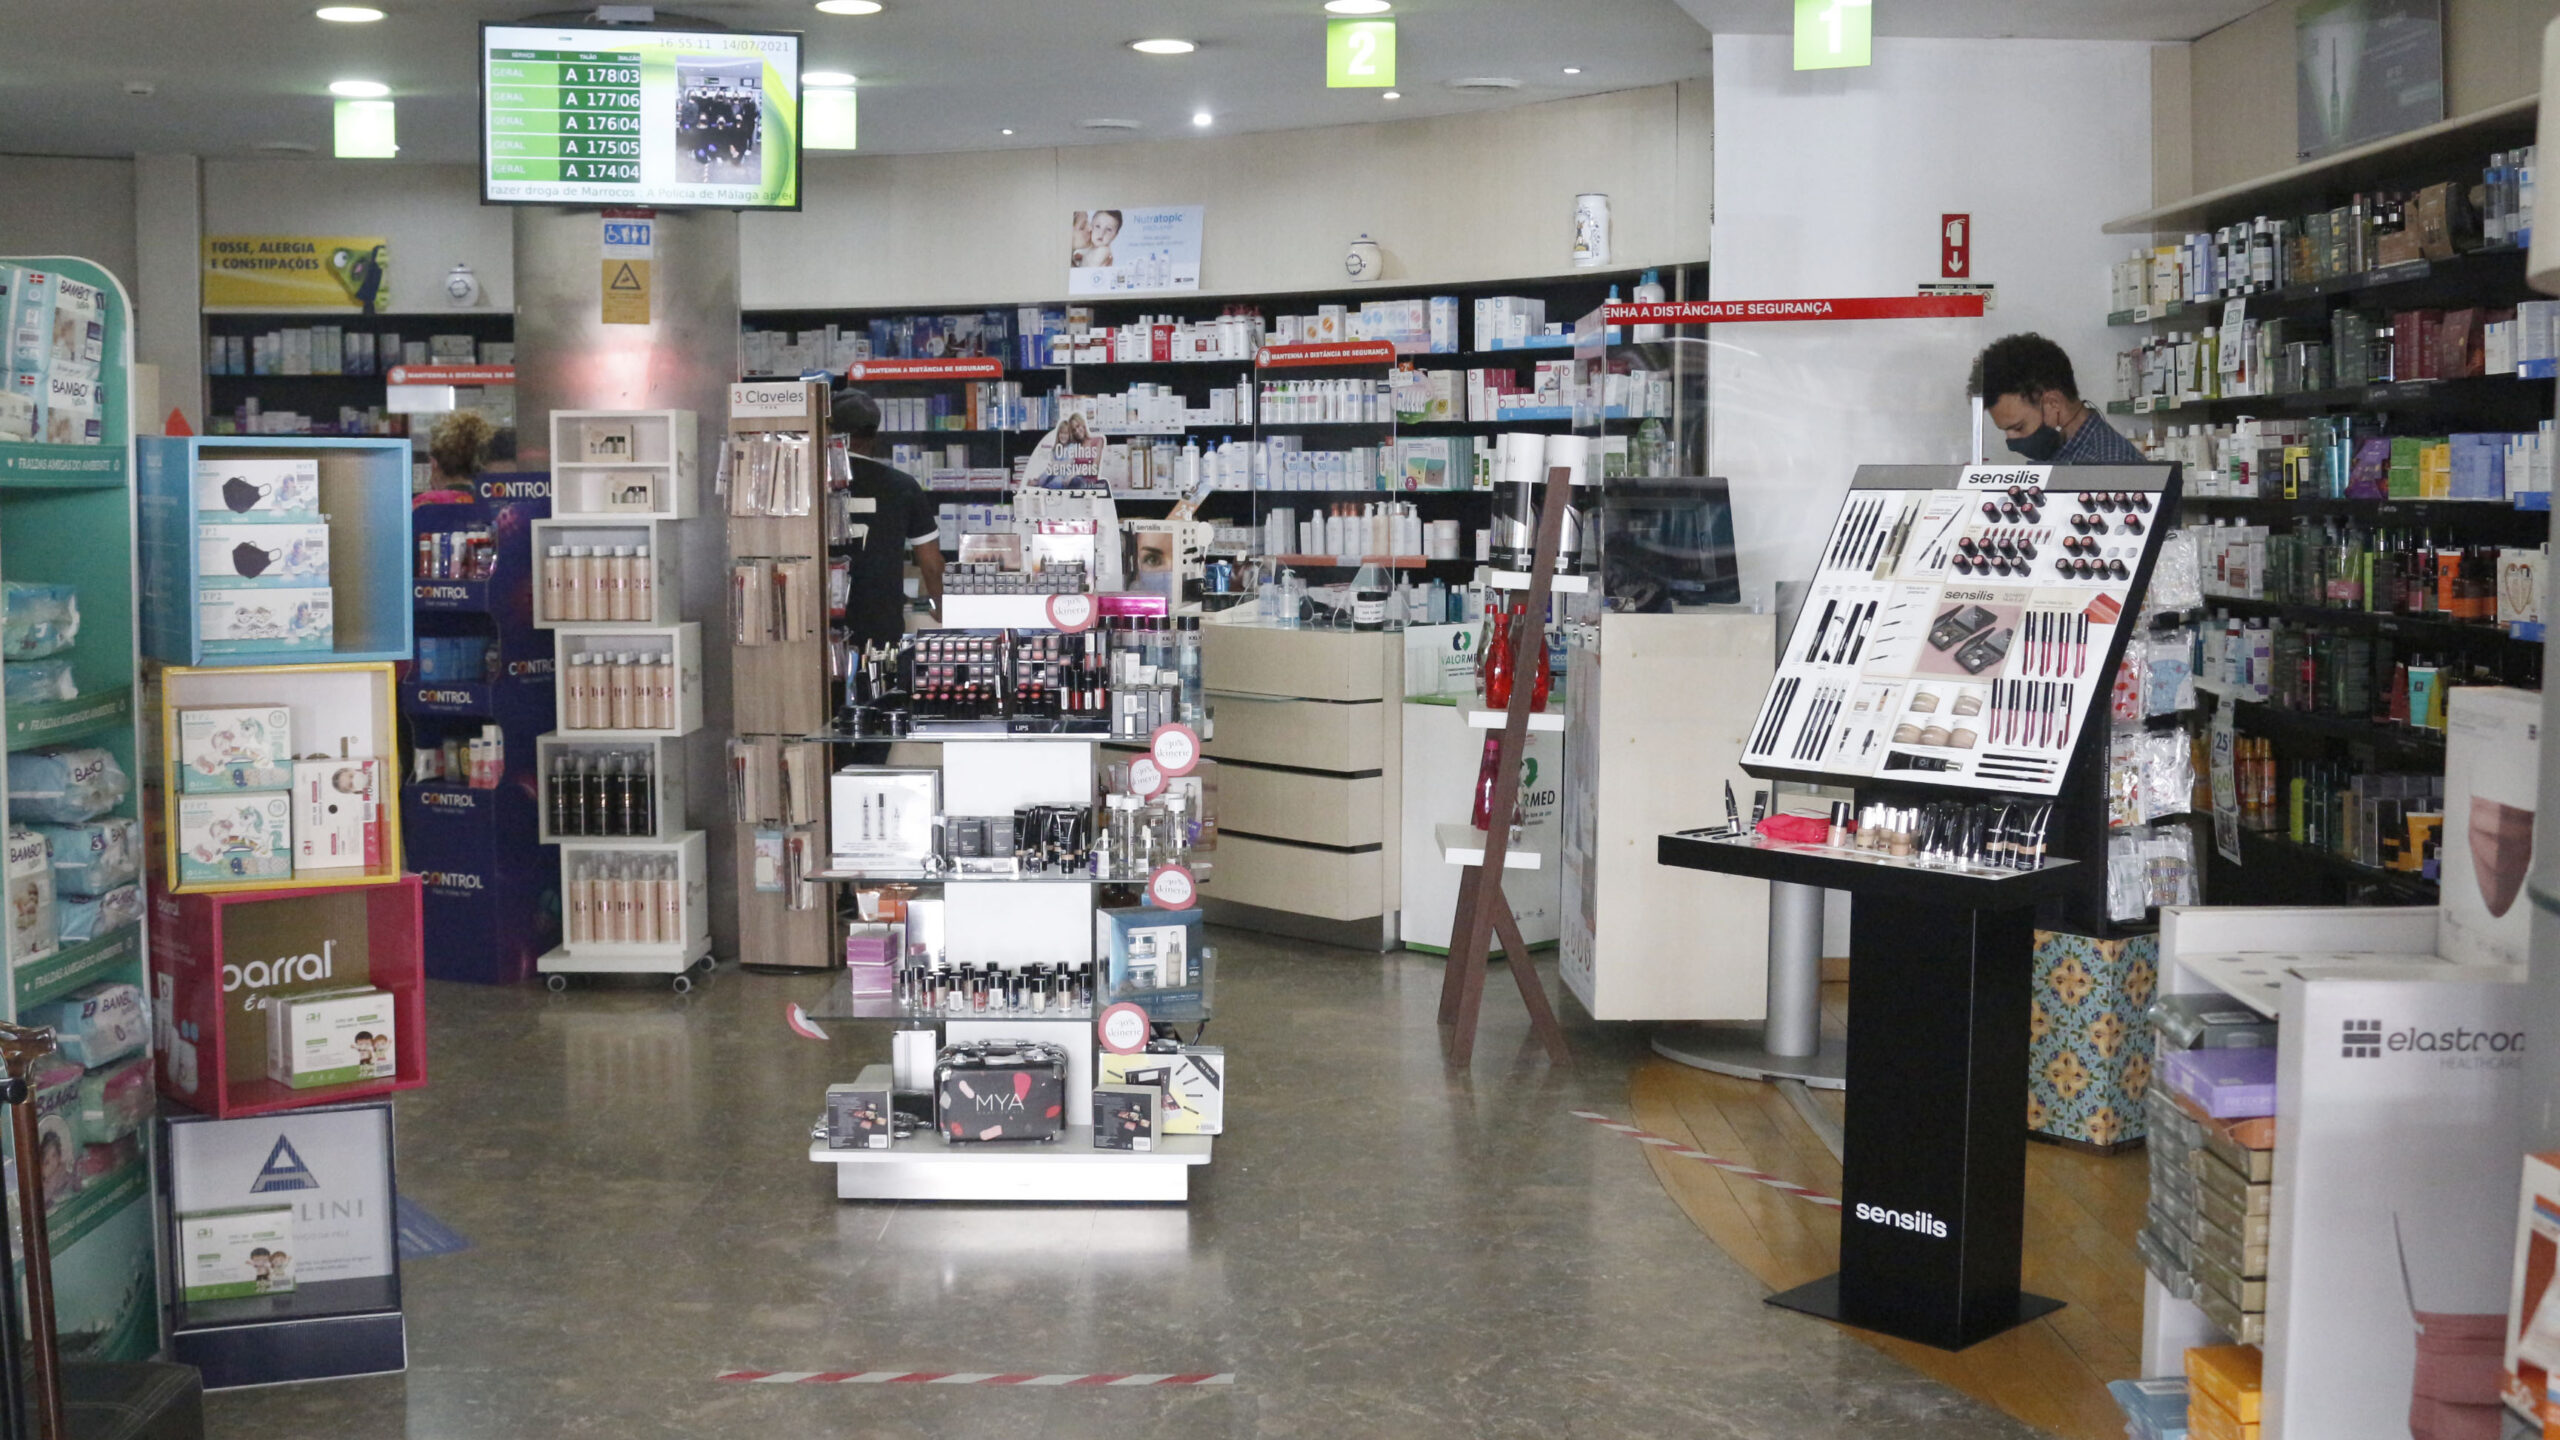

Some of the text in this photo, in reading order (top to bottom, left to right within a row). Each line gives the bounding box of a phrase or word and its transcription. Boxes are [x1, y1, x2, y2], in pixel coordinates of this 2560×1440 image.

[1819, 0, 1842, 53] 1
[722, 40, 789, 52] 14/07/2021
[1348, 31, 1376, 75] 2
[492, 67, 640, 84] GERAL A 178 03
[492, 91, 640, 109] GERAL A 177 06
[493, 115, 640, 133] GERAL A 176 04
[493, 139, 640, 157] GERAL A 175 05
[493, 164, 640, 181] GERAL A 174 04
[525, 186, 559, 197] droga
[563, 187, 577, 195] de
[582, 187, 635, 197] Marrocos
[699, 189, 713, 198] de
[717, 189, 759, 200] Málaga
[212, 242, 315, 255] TOSSE, ALERGIA
[211, 256, 320, 270] E CONSTIPAÇÕES
[60, 279, 90, 299] BAMBO
[1641, 306, 1650, 317] A
[1653, 303, 1723, 317] DISTÂNCIA
[1726, 304, 1744, 315] DE
[1747, 302, 1832, 315] SEGURANÇA
[1310, 350, 1340, 358] DISTÂNCIA
[1352, 348, 1388, 356] SEGURANÇA
[52, 379, 88, 398] BAMBO
[735, 390, 804, 403] 3 Claveles
[1055, 443, 1097, 459] Orelhas
[1969, 470, 2040, 484] sensilis
[481, 482, 552, 497] CONTROL
[414, 586, 469, 600] CONTROL
[1944, 590, 1994, 601] sensilis
[508, 659, 556, 675] CONTRO
[418, 690, 473, 704] CONTROL
[421, 792, 476, 807] CONTROL
[10, 843, 42, 863] BAMBO
[421, 871, 484, 889] CONTROL
[976, 1093, 1025, 1112] MYA
[1856, 1202, 1948, 1238] sensilis
